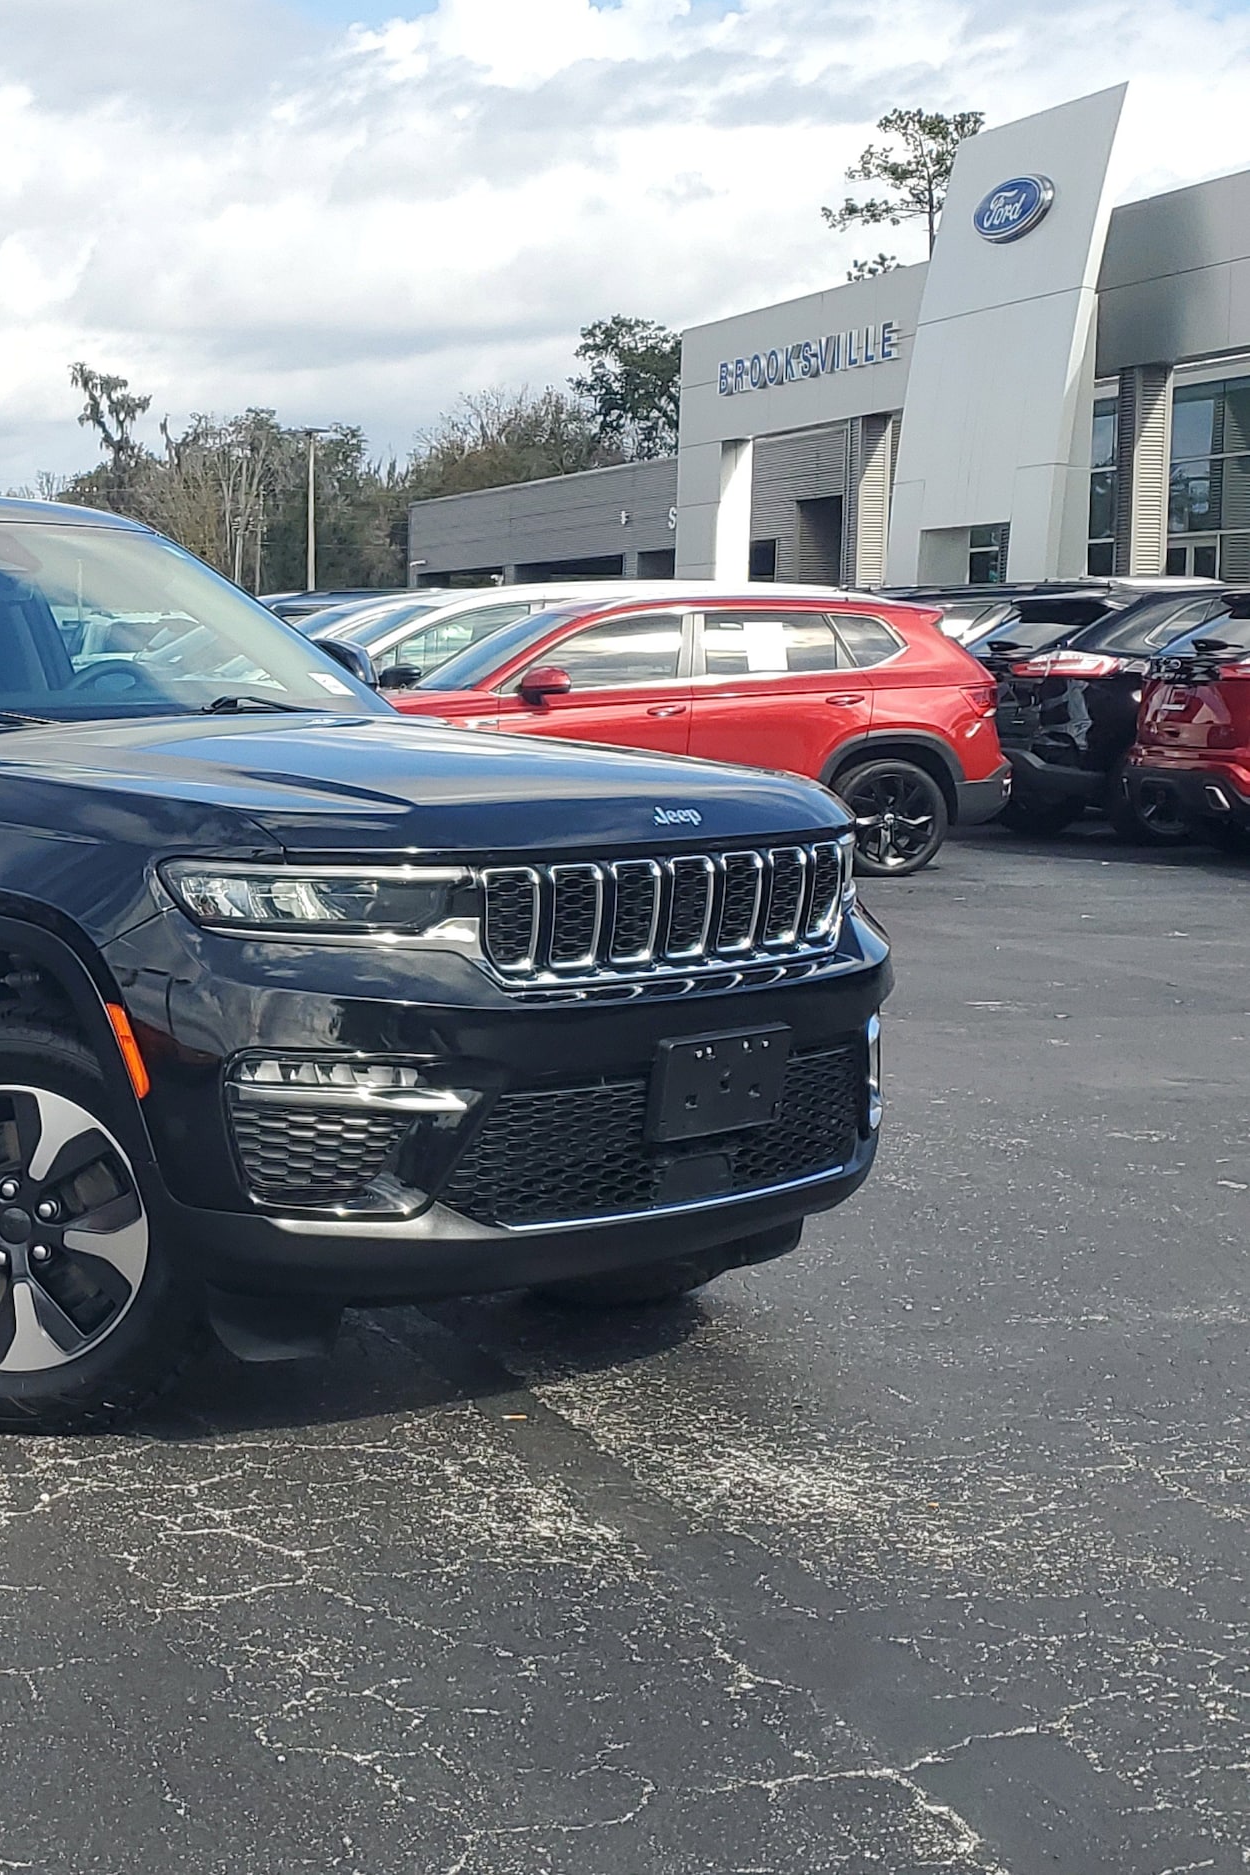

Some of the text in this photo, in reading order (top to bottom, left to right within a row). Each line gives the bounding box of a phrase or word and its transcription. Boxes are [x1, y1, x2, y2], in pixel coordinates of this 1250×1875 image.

[983, 188, 1027, 228] Ford
[718, 320, 899, 395] BROOKSVILLE
[653, 806, 703, 826] Jeep
